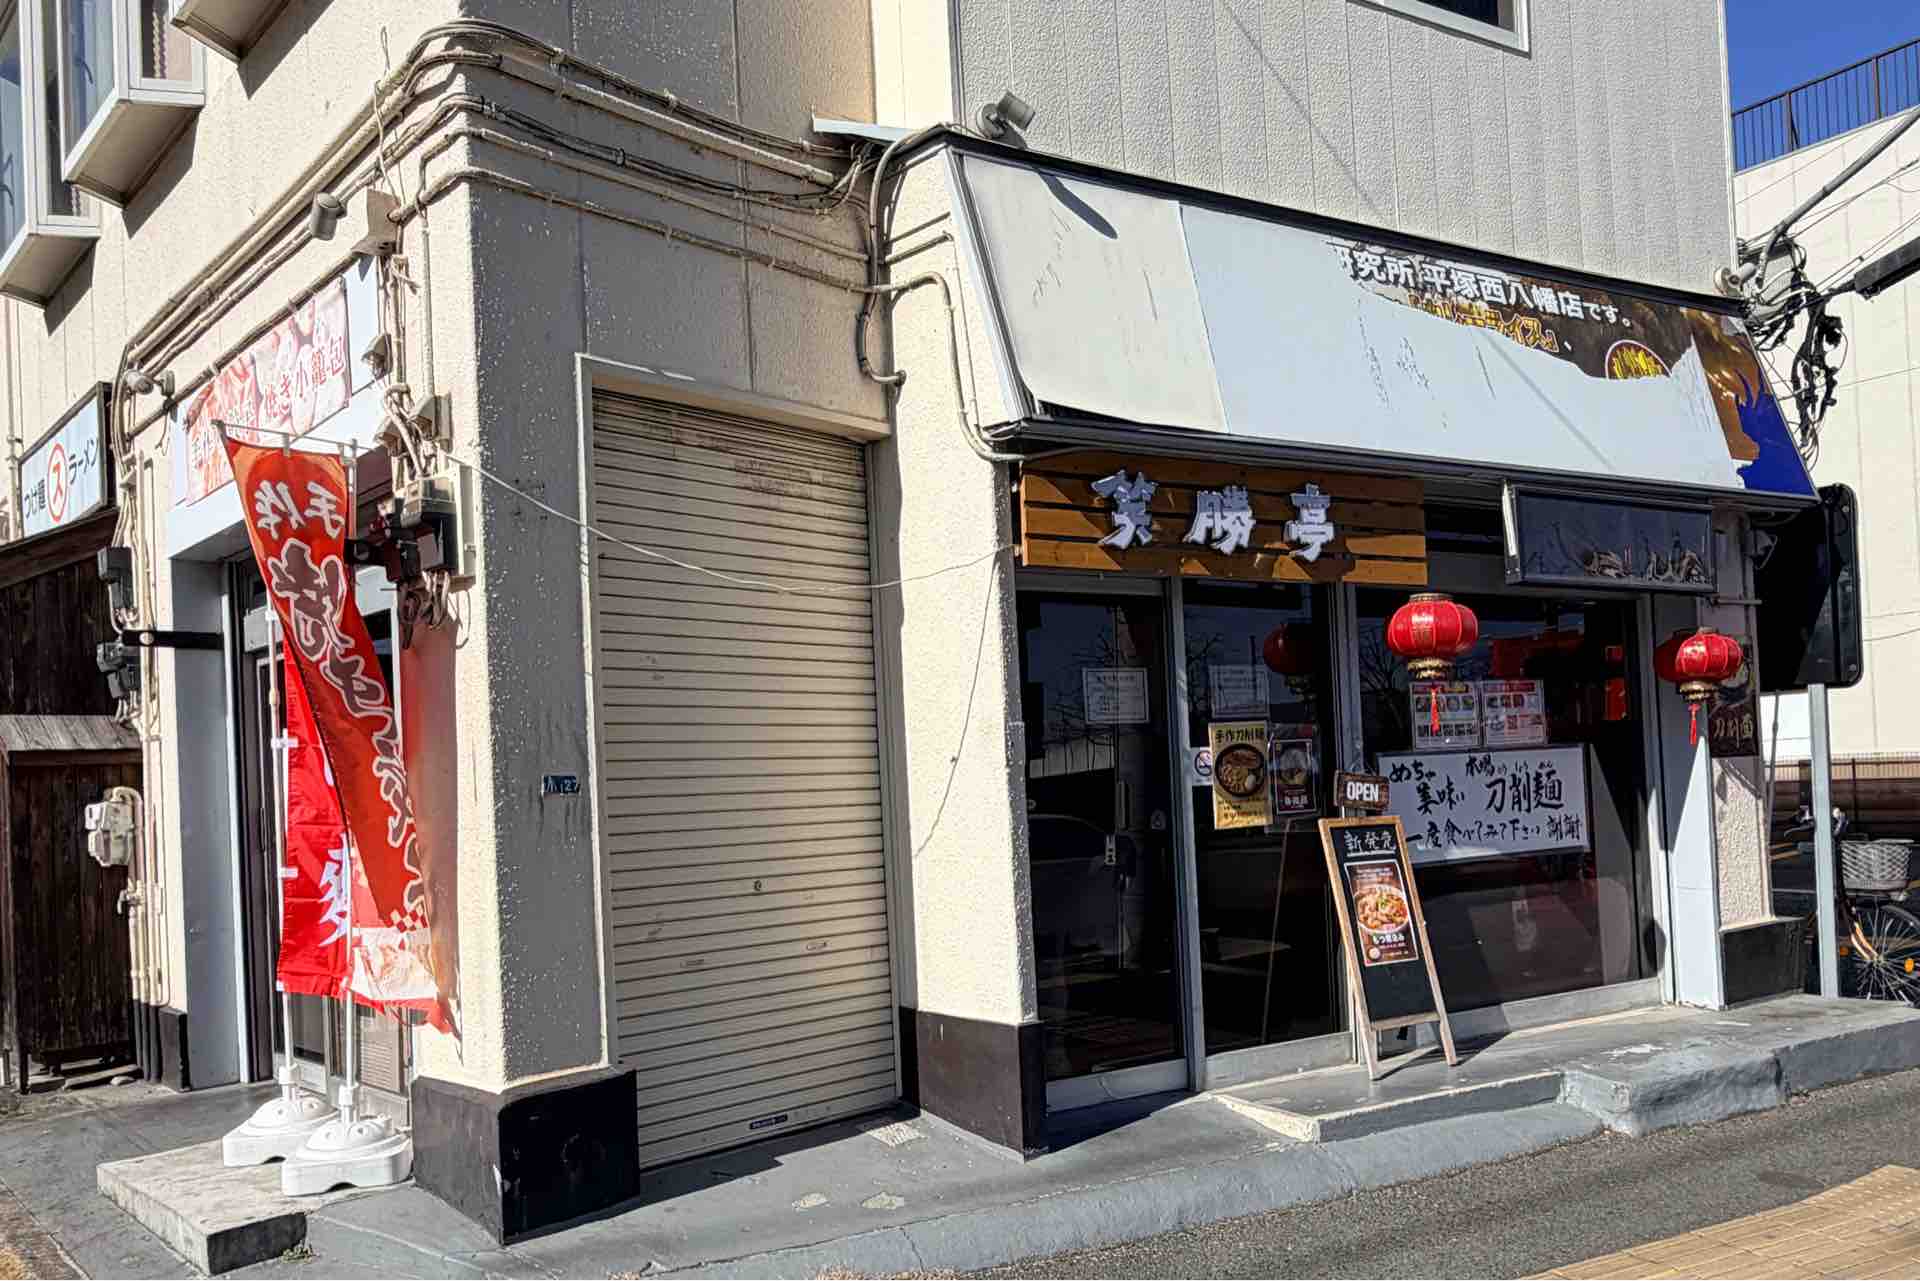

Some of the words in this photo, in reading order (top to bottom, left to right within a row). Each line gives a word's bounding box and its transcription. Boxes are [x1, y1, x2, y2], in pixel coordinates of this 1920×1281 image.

[53, 462, 63, 504] ス
[69, 437, 98, 486] ラーメン
[1346, 781, 1379, 801] OPEN
[1389, 760, 1437, 784] めちゃ
[1485, 770, 1565, 814] 刀削麺
[1416, 775, 1465, 816] 美味い
